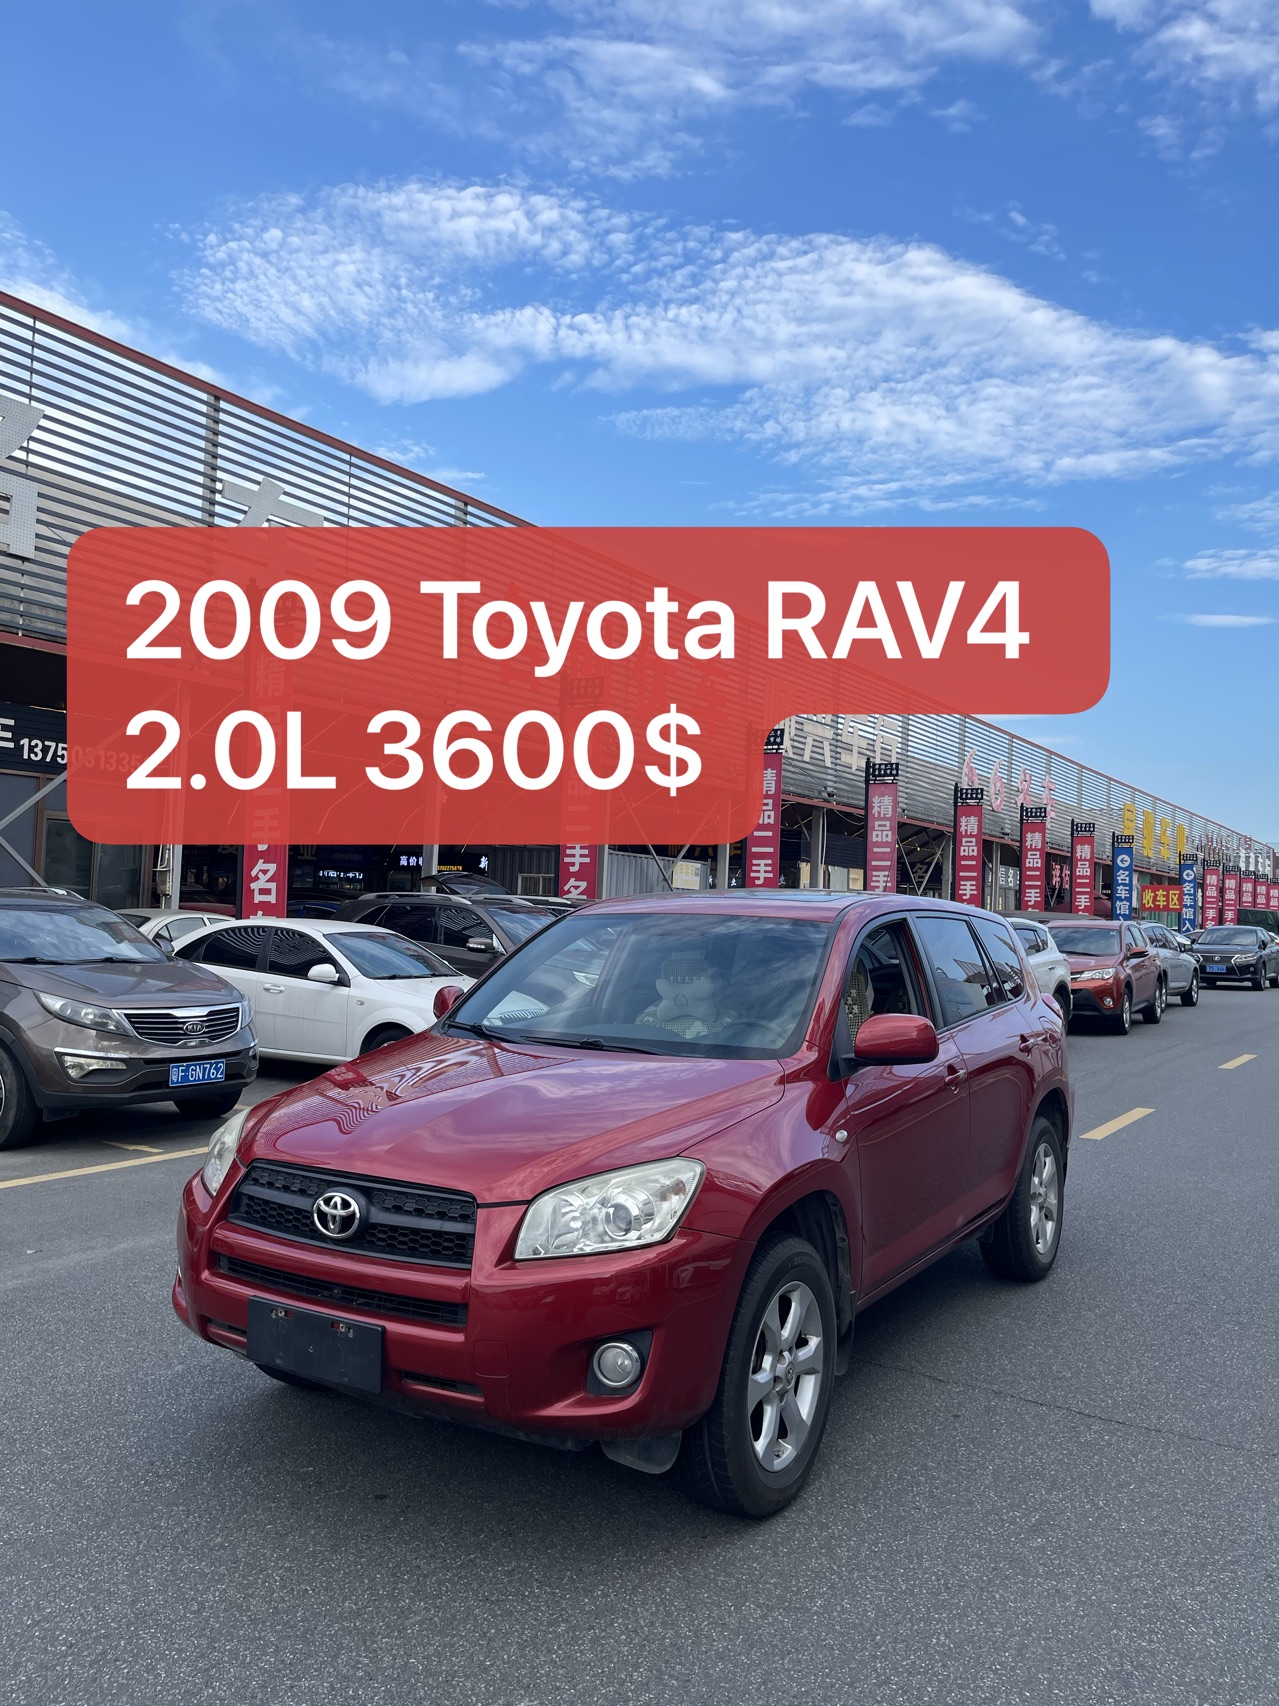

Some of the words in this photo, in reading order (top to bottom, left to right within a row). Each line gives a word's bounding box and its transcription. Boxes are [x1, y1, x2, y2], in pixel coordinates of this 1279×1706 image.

[958, 815, 980, 907] 精品二手
[1024, 832, 1042, 912] 精品二手
[1075, 844, 1091, 915] 精品二手
[1142, 889, 1180, 909] 收车区
[187, 1023, 205, 1034] KIA
